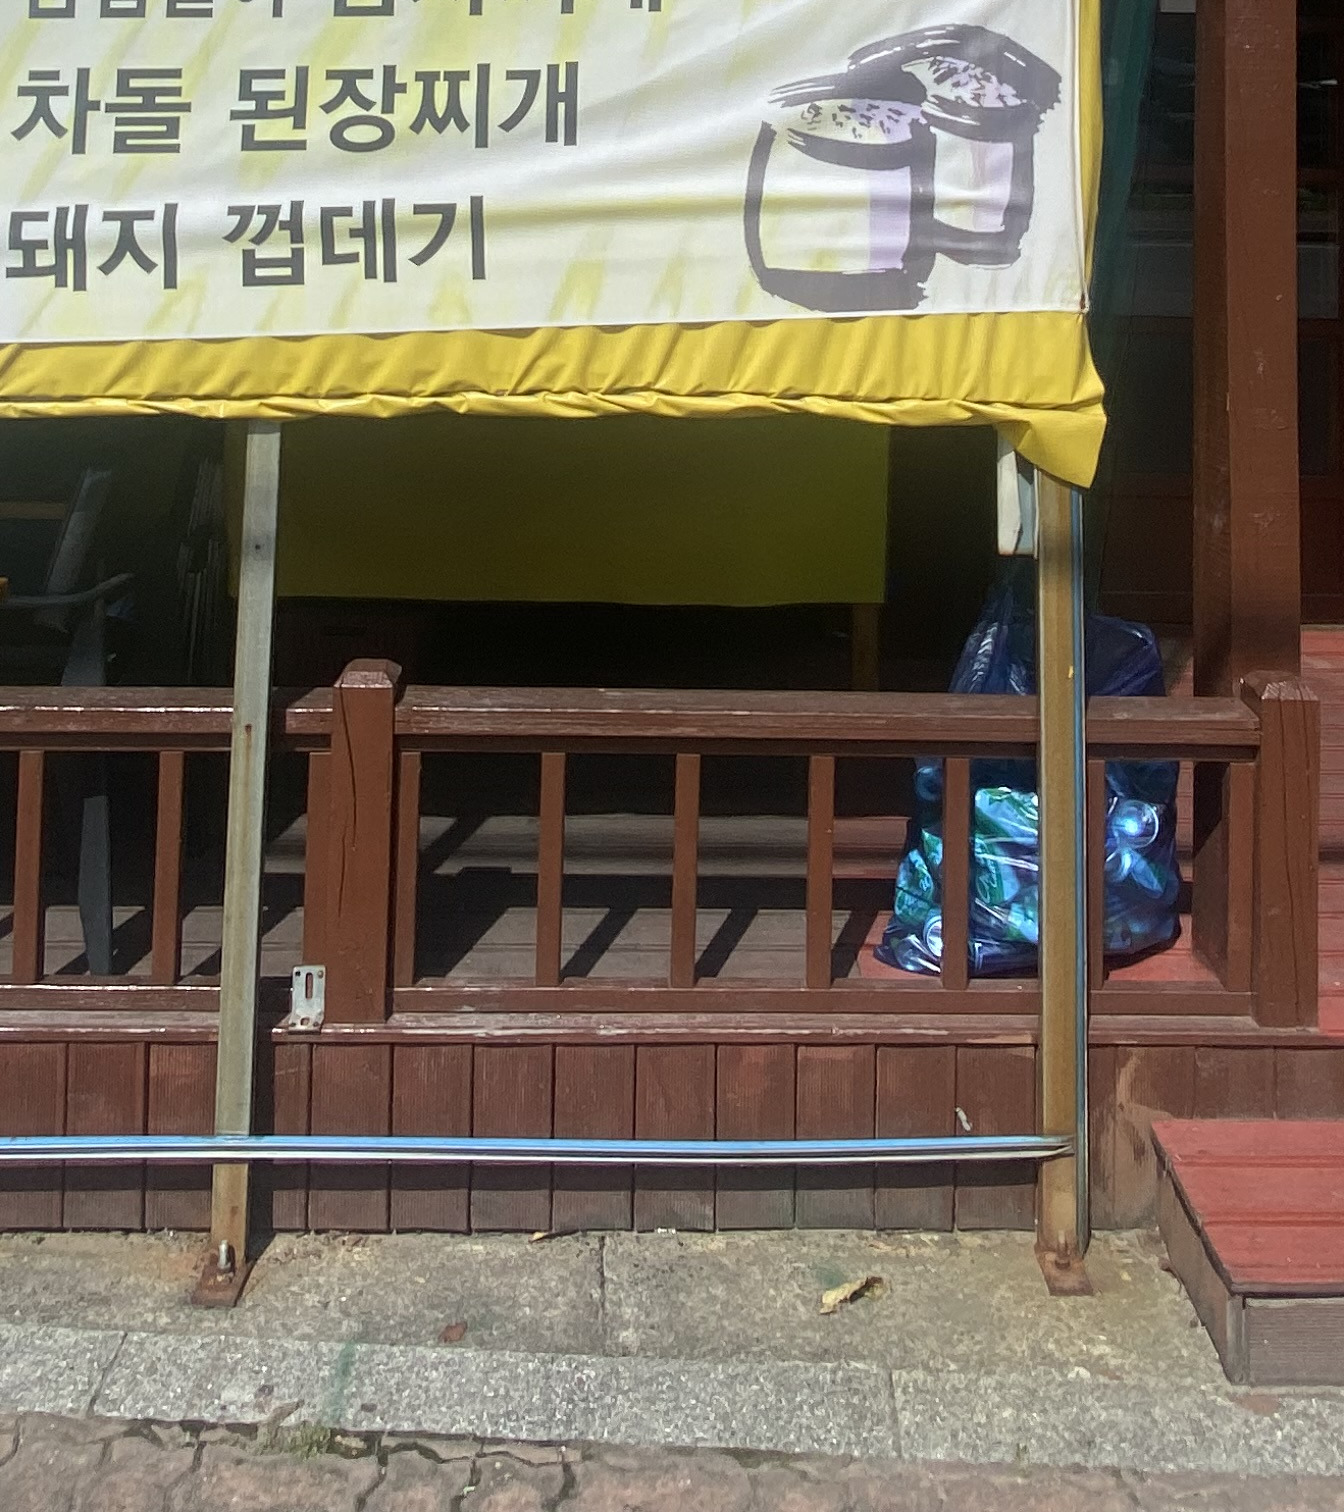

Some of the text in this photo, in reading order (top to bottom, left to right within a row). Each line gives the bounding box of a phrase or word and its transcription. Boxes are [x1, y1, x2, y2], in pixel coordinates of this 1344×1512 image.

[10, 61, 579, 154] 차돌 된장찌개
[5, 196, 488, 291] 돼지 껍데기
